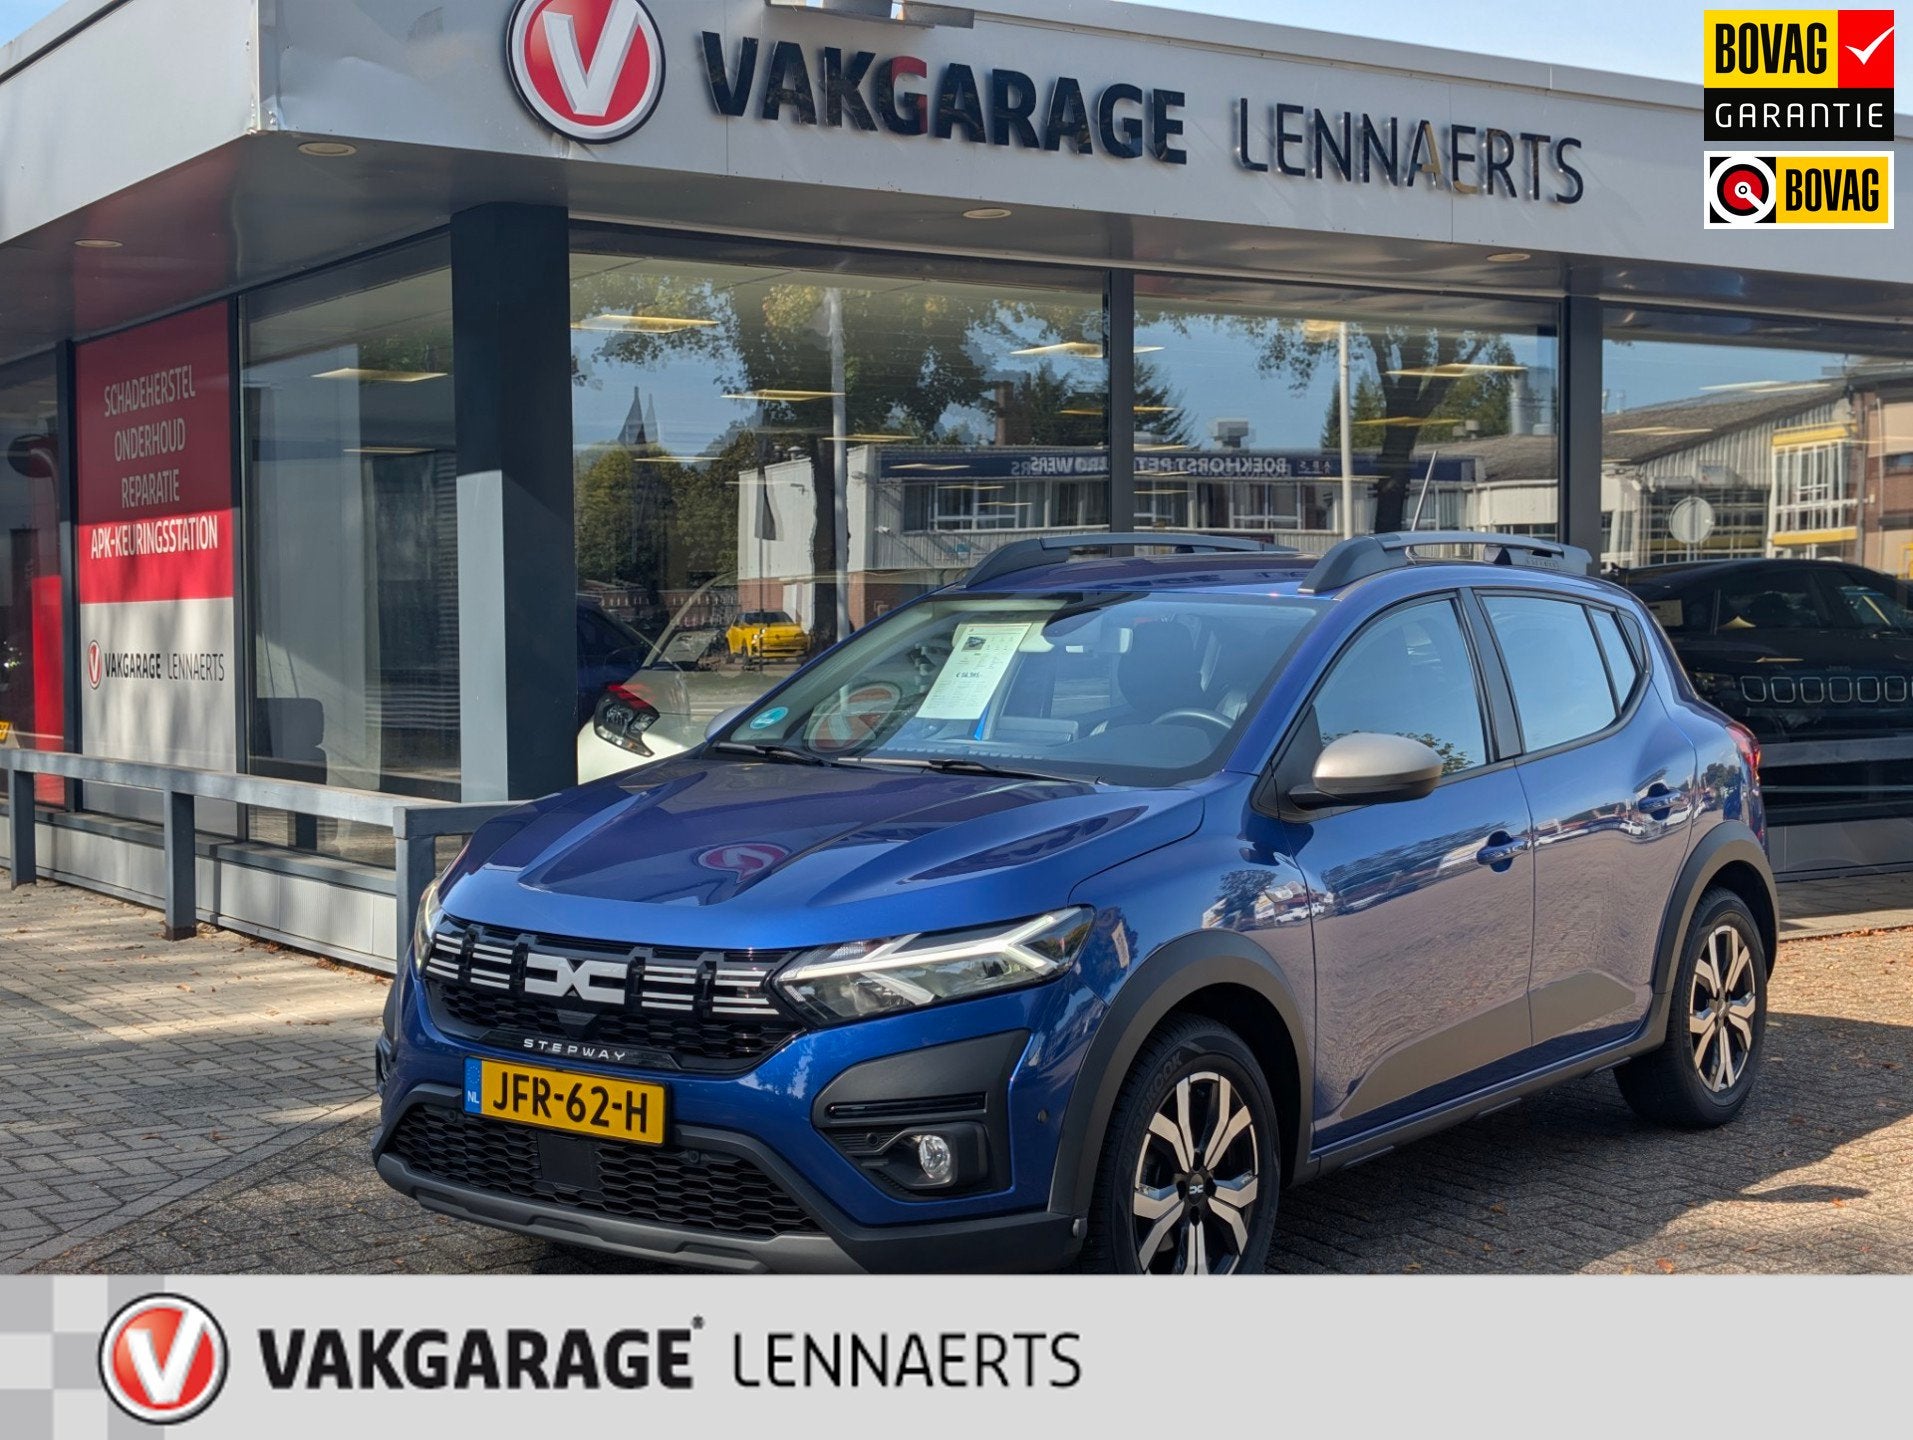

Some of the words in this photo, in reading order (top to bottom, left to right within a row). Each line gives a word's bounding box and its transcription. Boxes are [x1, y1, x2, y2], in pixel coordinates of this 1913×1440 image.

[701, 30, 1188, 165] VAKGARAGE
[1239, 97, 1585, 205] LENNAERTS
[104, 364, 196, 417] SCHADEHERSTEL
[115, 417, 186, 462] ONDERHOUD
[121, 468, 180, 509] REPARATIE
[90, 514, 218, 560] APK-KEURINGSSTATION
[104, 652, 161, 679] VAKGARAGE
[167, 652, 225, 682] LENNAERTS
[523, 1038, 626, 1061] STEPWAY
[467, 1090, 480, 1104] NL
[492, 1071, 648, 1134] JFR-62-H
